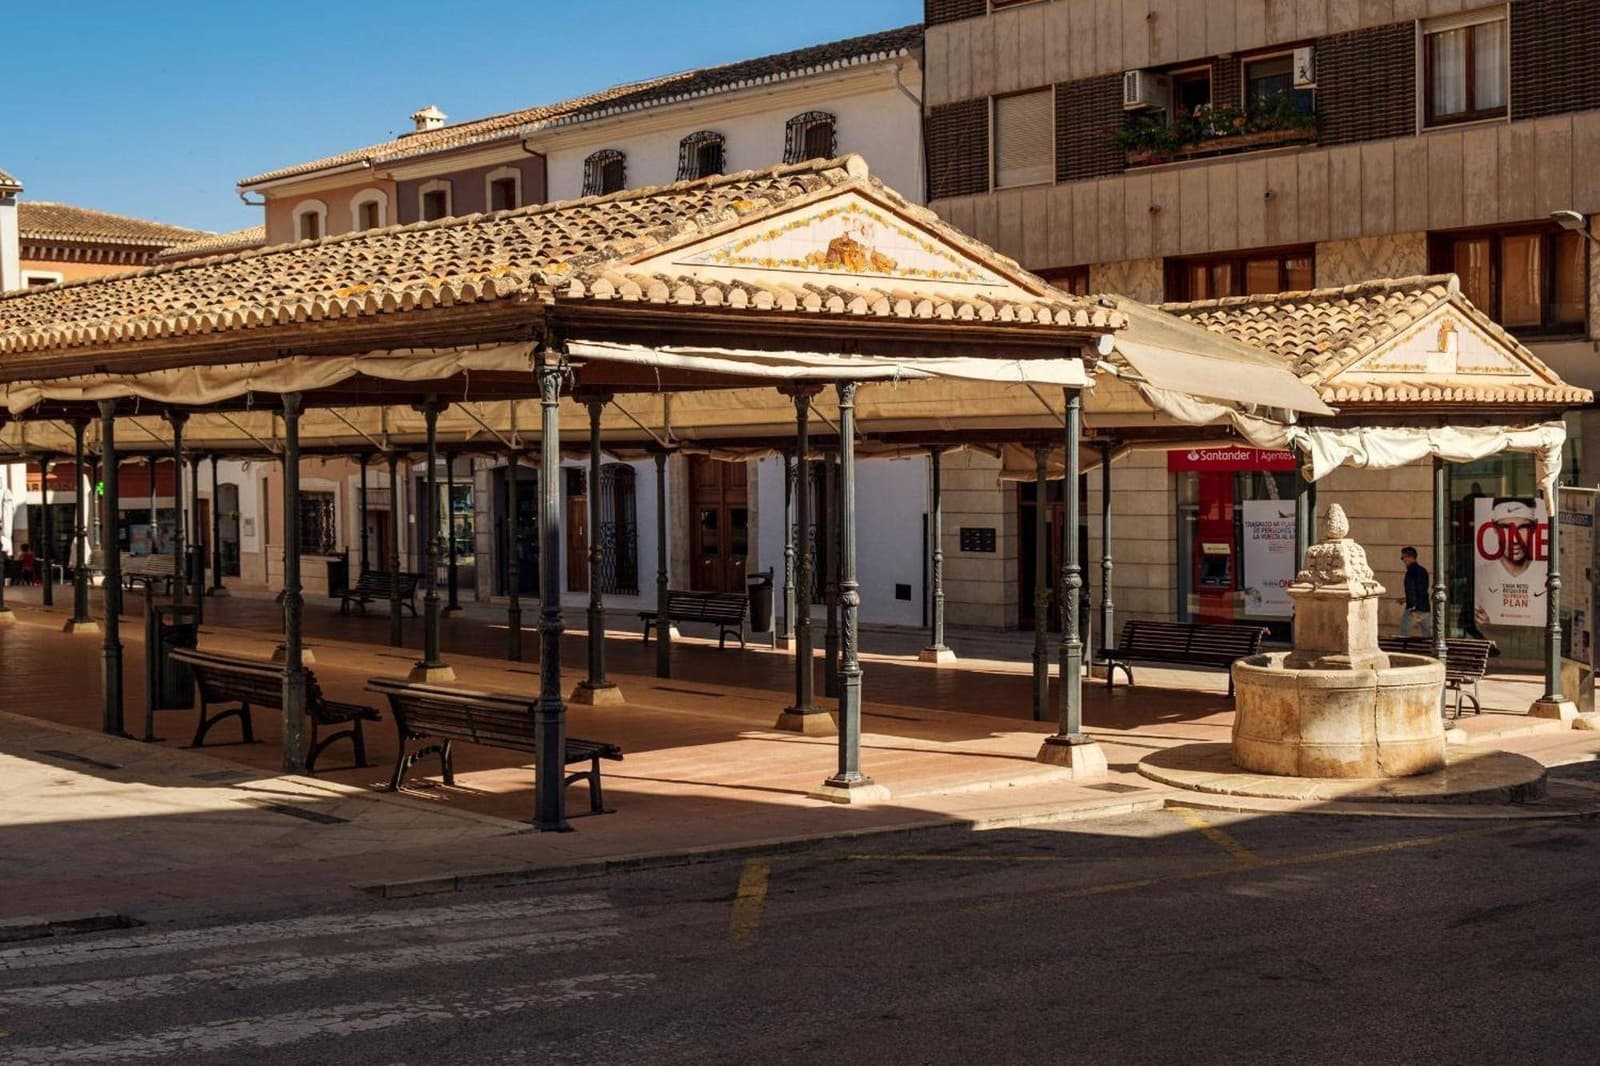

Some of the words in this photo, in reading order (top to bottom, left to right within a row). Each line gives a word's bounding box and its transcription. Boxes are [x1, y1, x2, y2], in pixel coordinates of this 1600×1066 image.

[1200, 450, 1250, 461] Santander
[1477, 521, 1550, 562] ONE
[1503, 599, 1528, 608] PLAN
